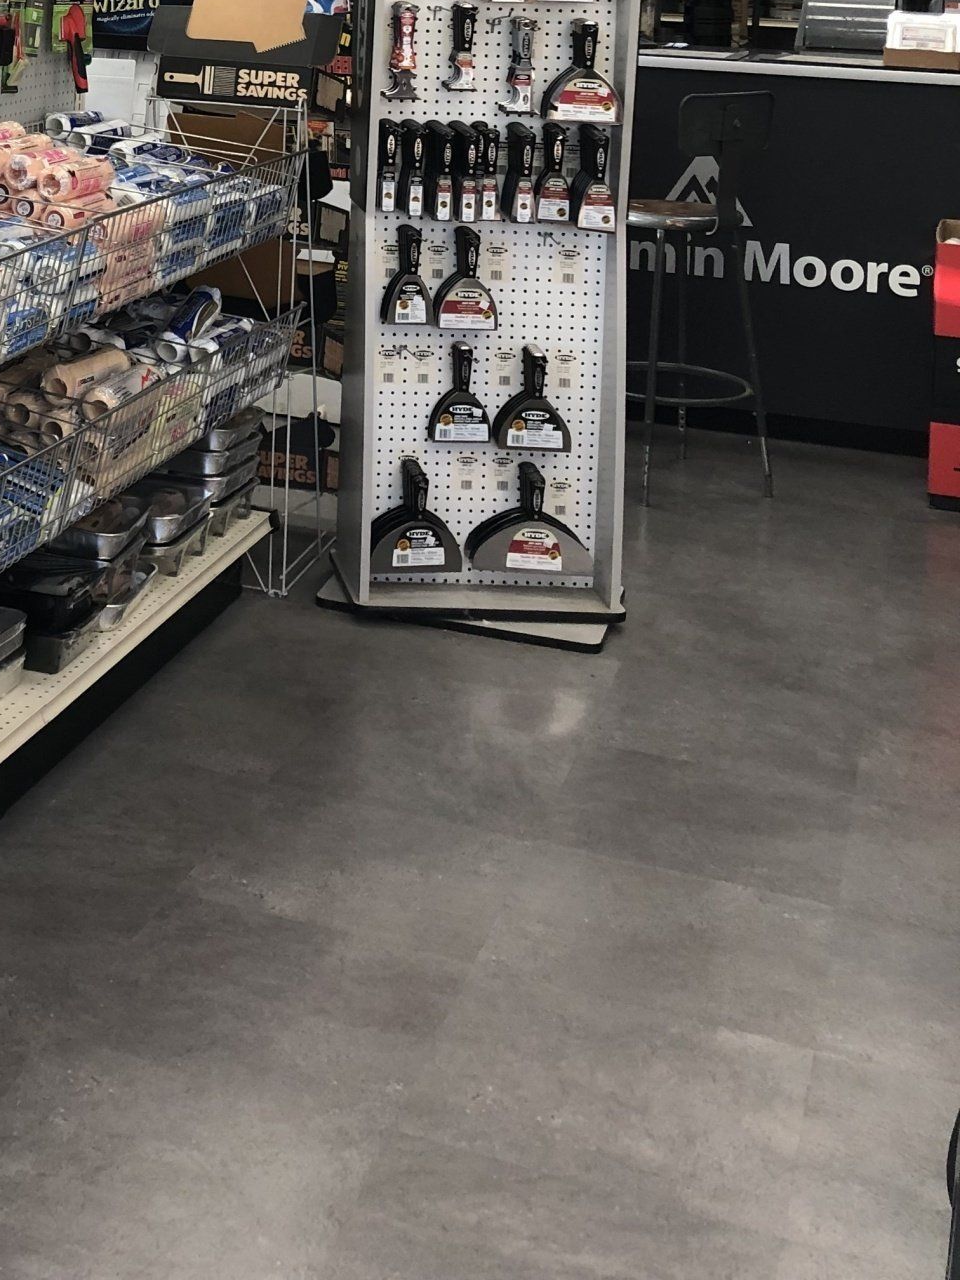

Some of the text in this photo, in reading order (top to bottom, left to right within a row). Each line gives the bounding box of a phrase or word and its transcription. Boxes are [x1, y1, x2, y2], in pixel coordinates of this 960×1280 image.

[97, 13, 146, 24] magically eliminates
[238, 68, 300, 88] SUPER
[236, 83, 308, 100] SAVINGS
